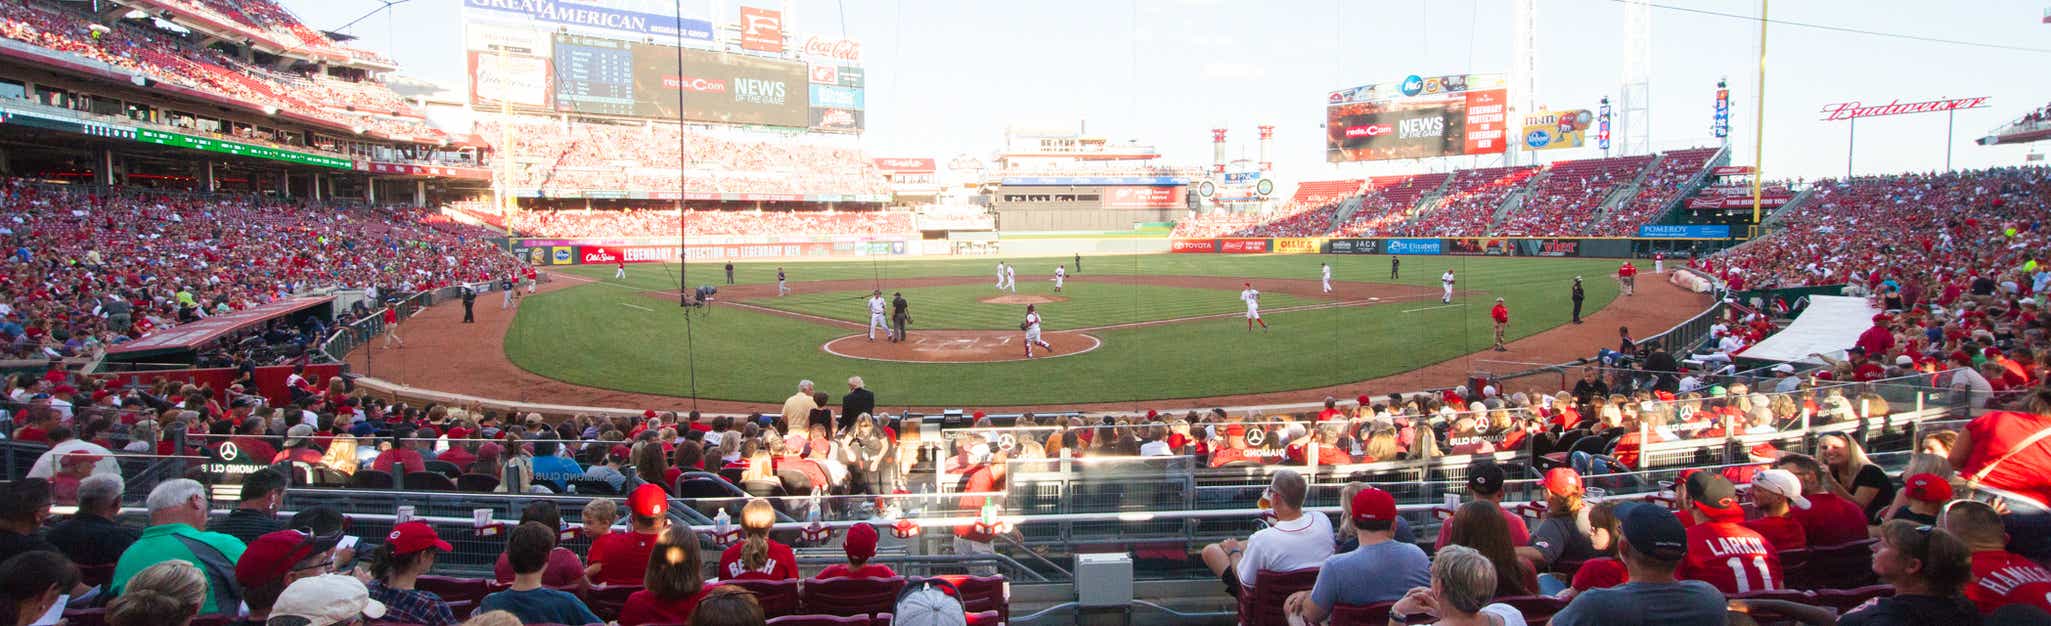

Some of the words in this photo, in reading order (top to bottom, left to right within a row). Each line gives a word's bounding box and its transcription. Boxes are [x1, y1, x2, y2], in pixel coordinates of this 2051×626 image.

[541, 3, 645, 31] AMERICAN
[734, 77, 785, 97] NEWS
[1823, 96, 1986, 121] Budweiser
[1400, 116, 1444, 133] NEWS
[1705, 536, 1768, 557] LARKIN
[728, 558, 777, 578] BEH
[1726, 555, 1775, 593] 11
